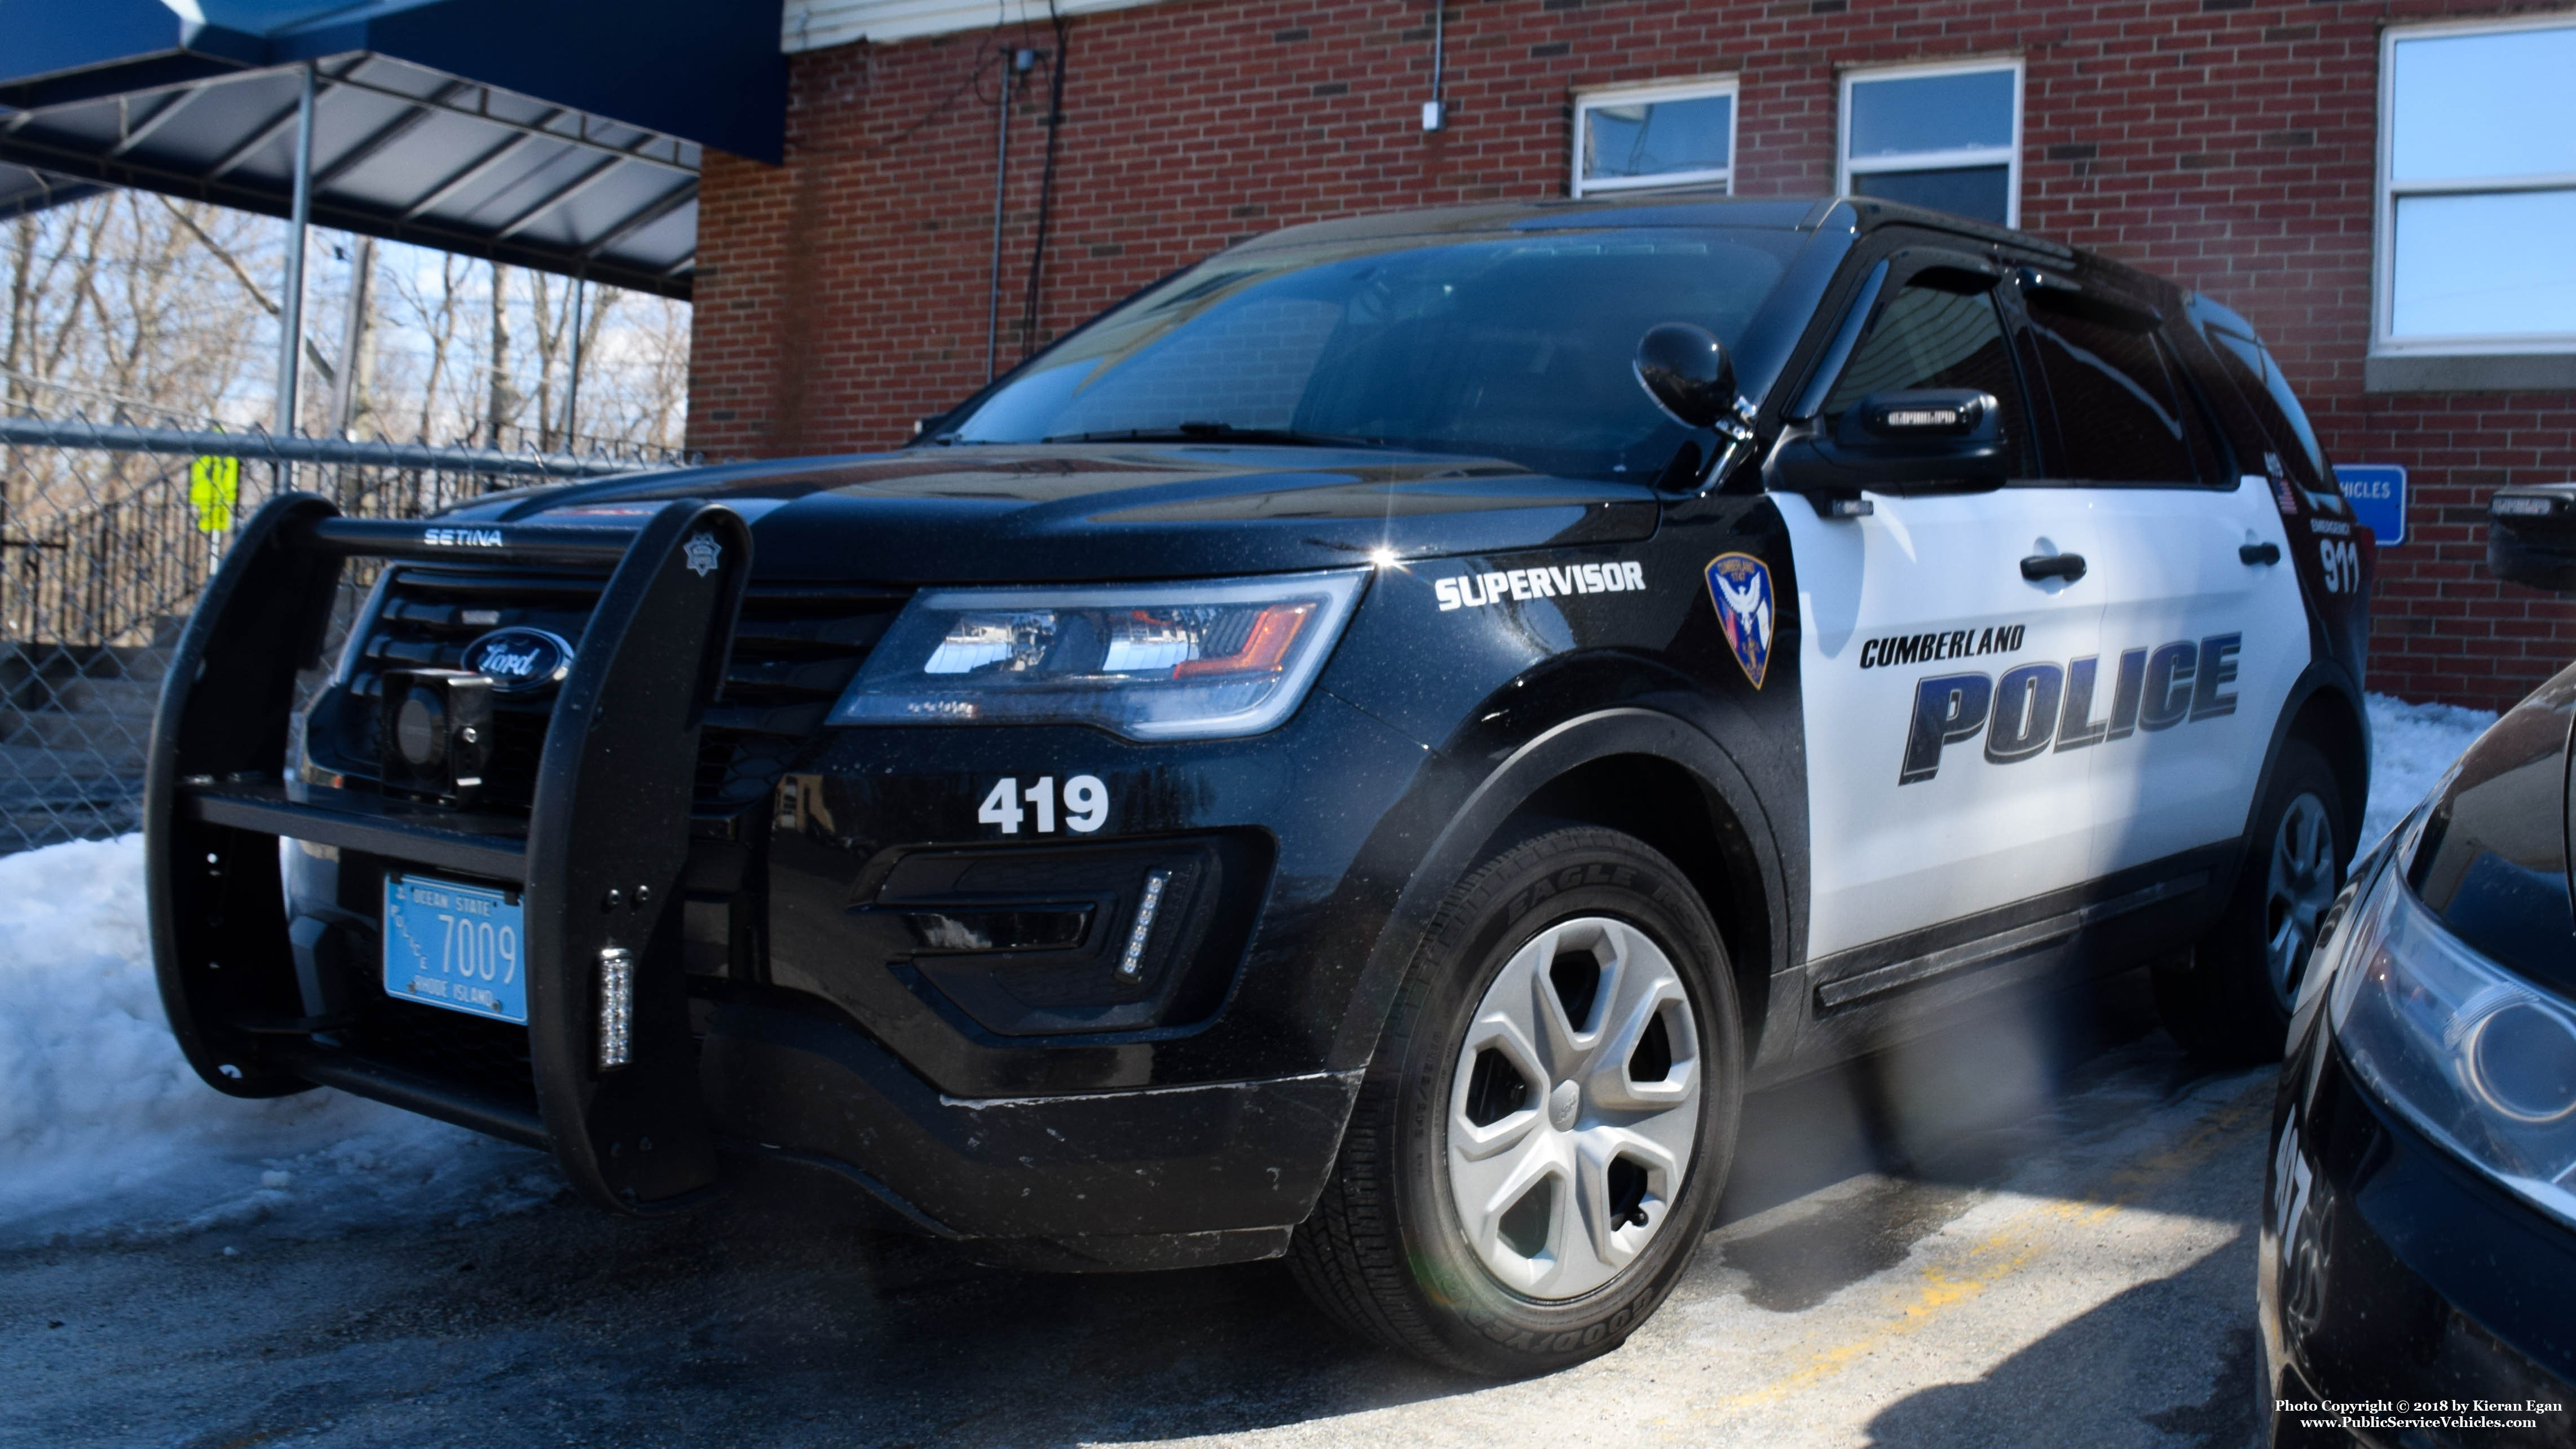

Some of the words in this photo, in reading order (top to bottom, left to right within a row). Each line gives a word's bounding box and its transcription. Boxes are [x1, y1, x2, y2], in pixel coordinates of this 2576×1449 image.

[424, 529, 503, 547] SETINA
[1435, 562, 1646, 611] SUPERVISOR
[2319, 538, 2359, 594] 911
[478, 643, 541, 676] Ford
[1860, 624, 2026, 669] CUMBERLAND
[1898, 631, 2242, 787] POLICE
[978, 775, 1109, 834] 419
[413, 889, 449, 909] OCEAN
[456, 896, 492, 917] STATE
[1506, 864, 1638, 925] EAGLE
[390, 904, 428, 970] POLICE
[438, 914, 517, 984] 7009
[414, 974, 448, 998] RHODE
[453, 984, 494, 1008] ISLAND
